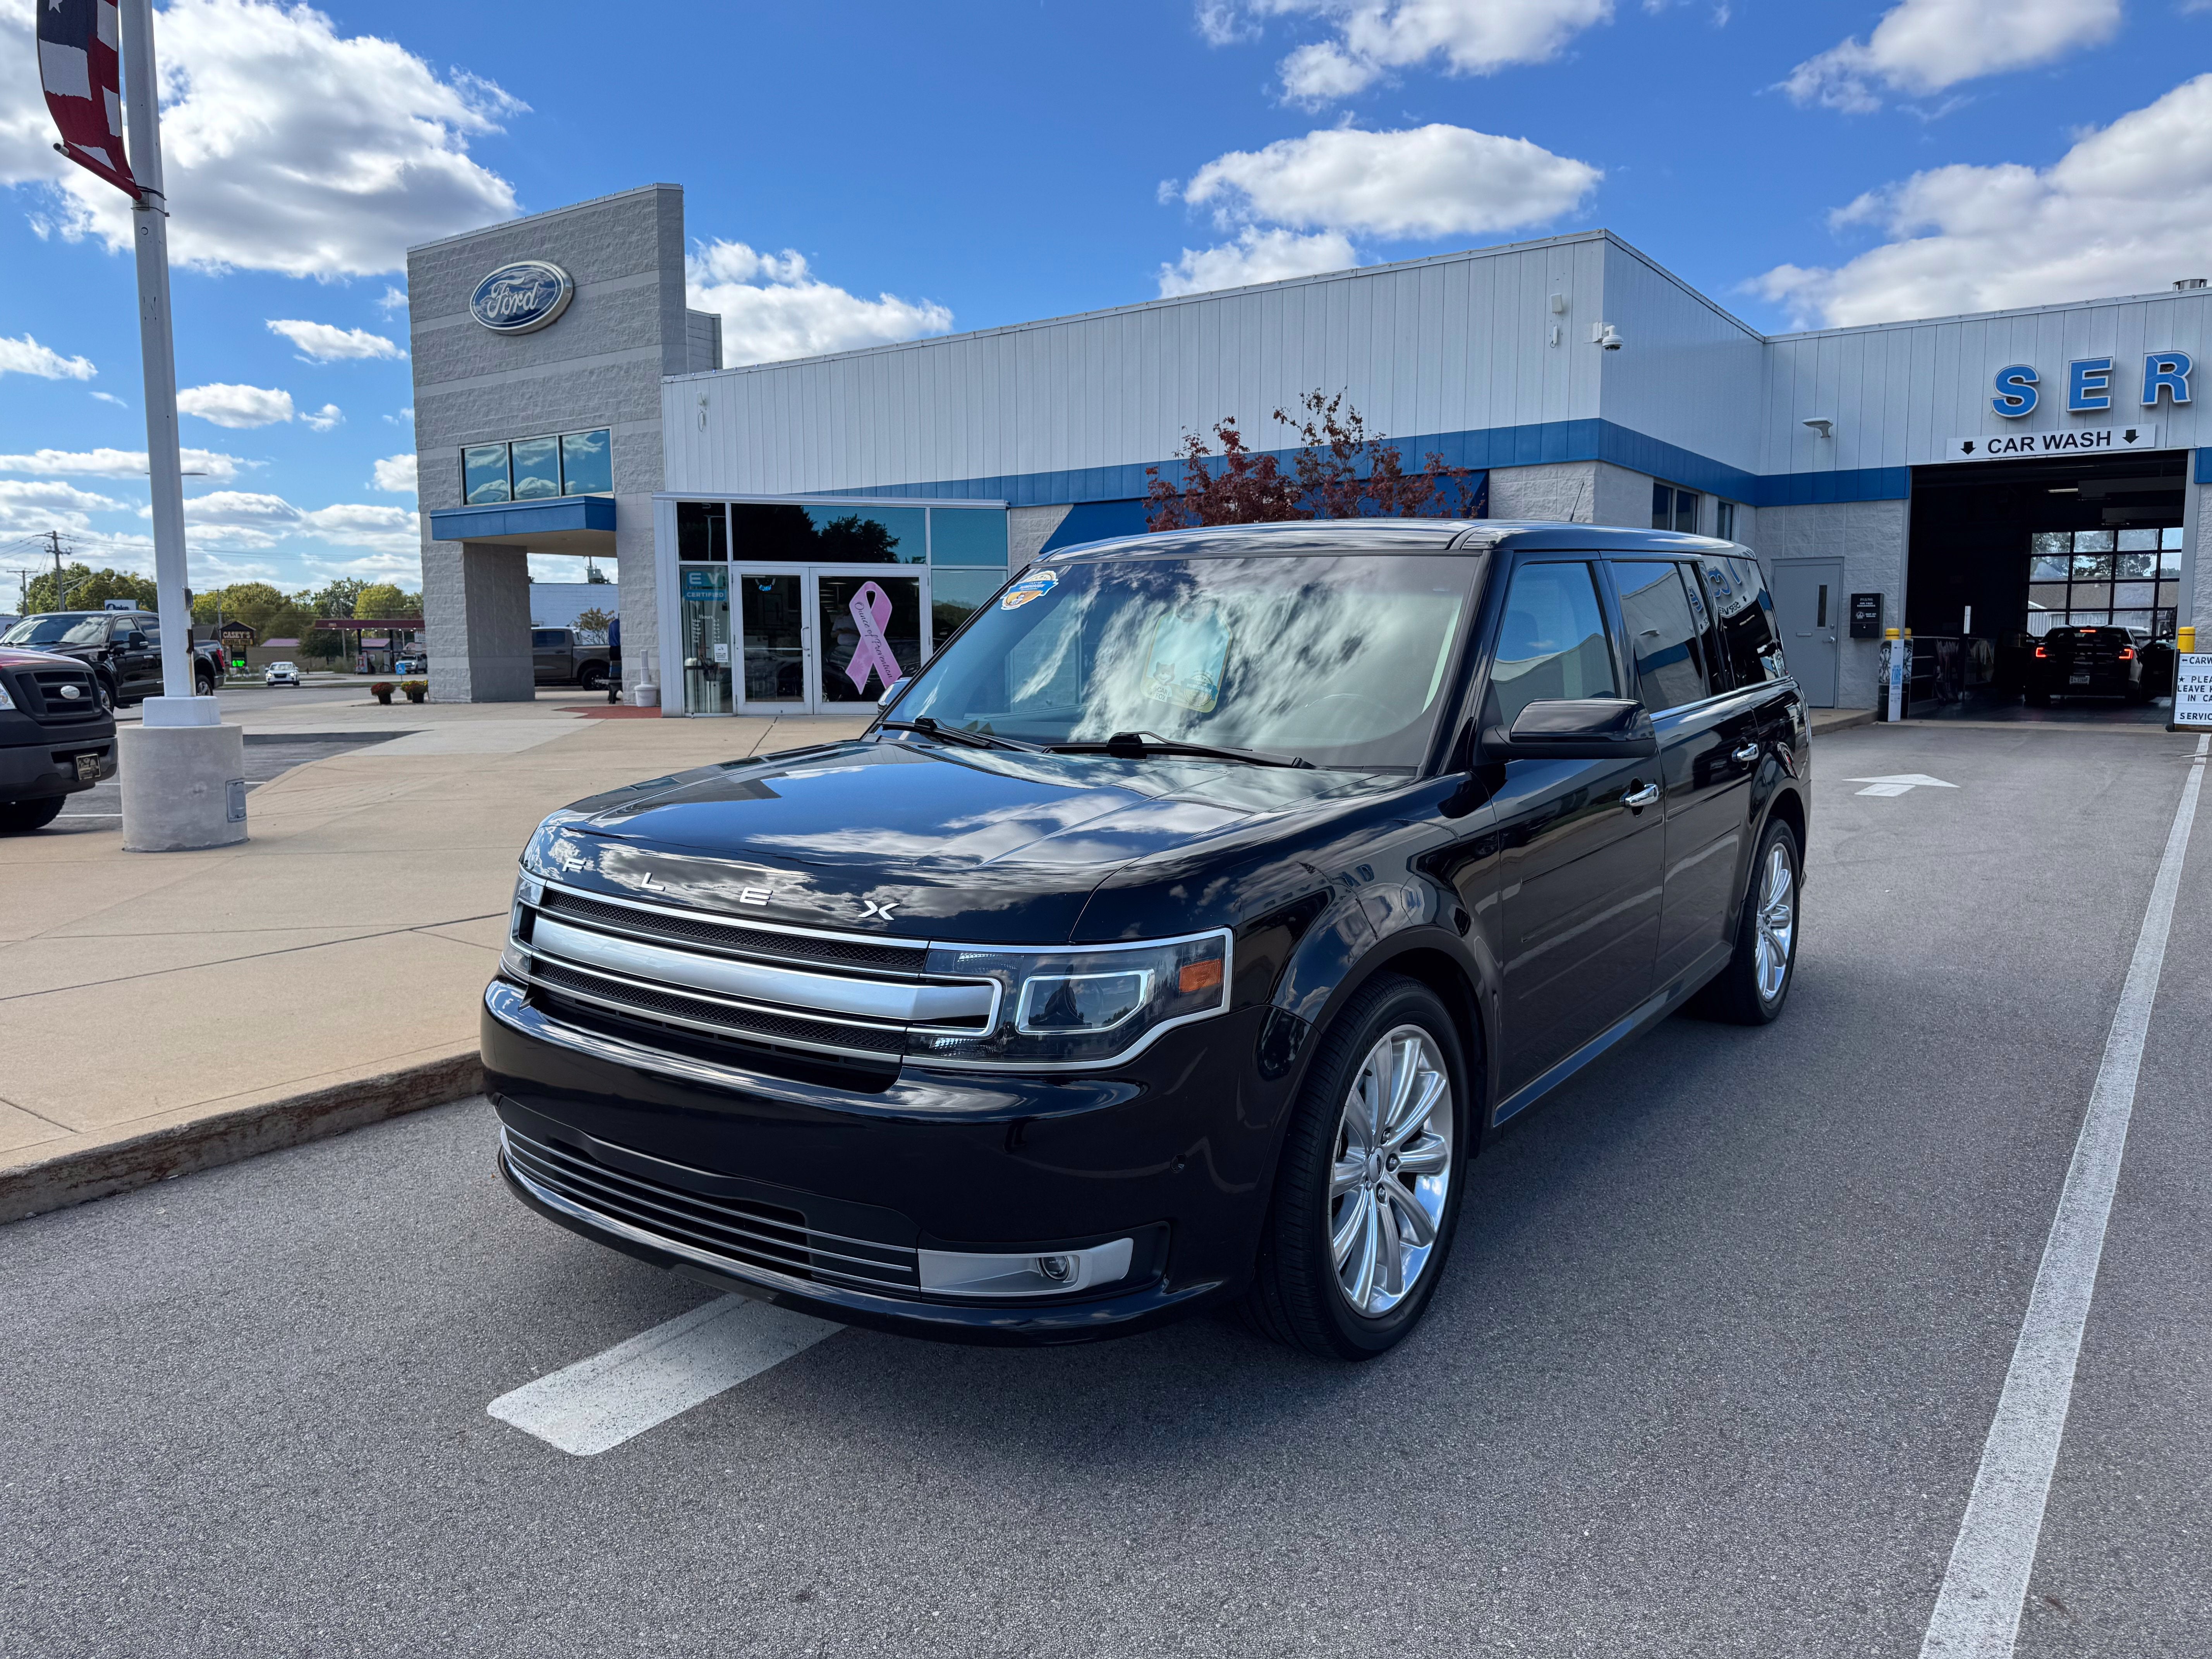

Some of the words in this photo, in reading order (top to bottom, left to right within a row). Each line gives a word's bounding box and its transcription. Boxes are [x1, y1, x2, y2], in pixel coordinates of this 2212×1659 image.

[487, 276, 539, 318] Ford
[1987, 436, 2035, 454] CAR
[2042, 430, 2111, 450] WASH
[855, 601, 870, 628] Ounce
[865, 630, 878, 638] of
[872, 639, 892, 678] Prevention
[562, 858, 900, 921] FLEX
